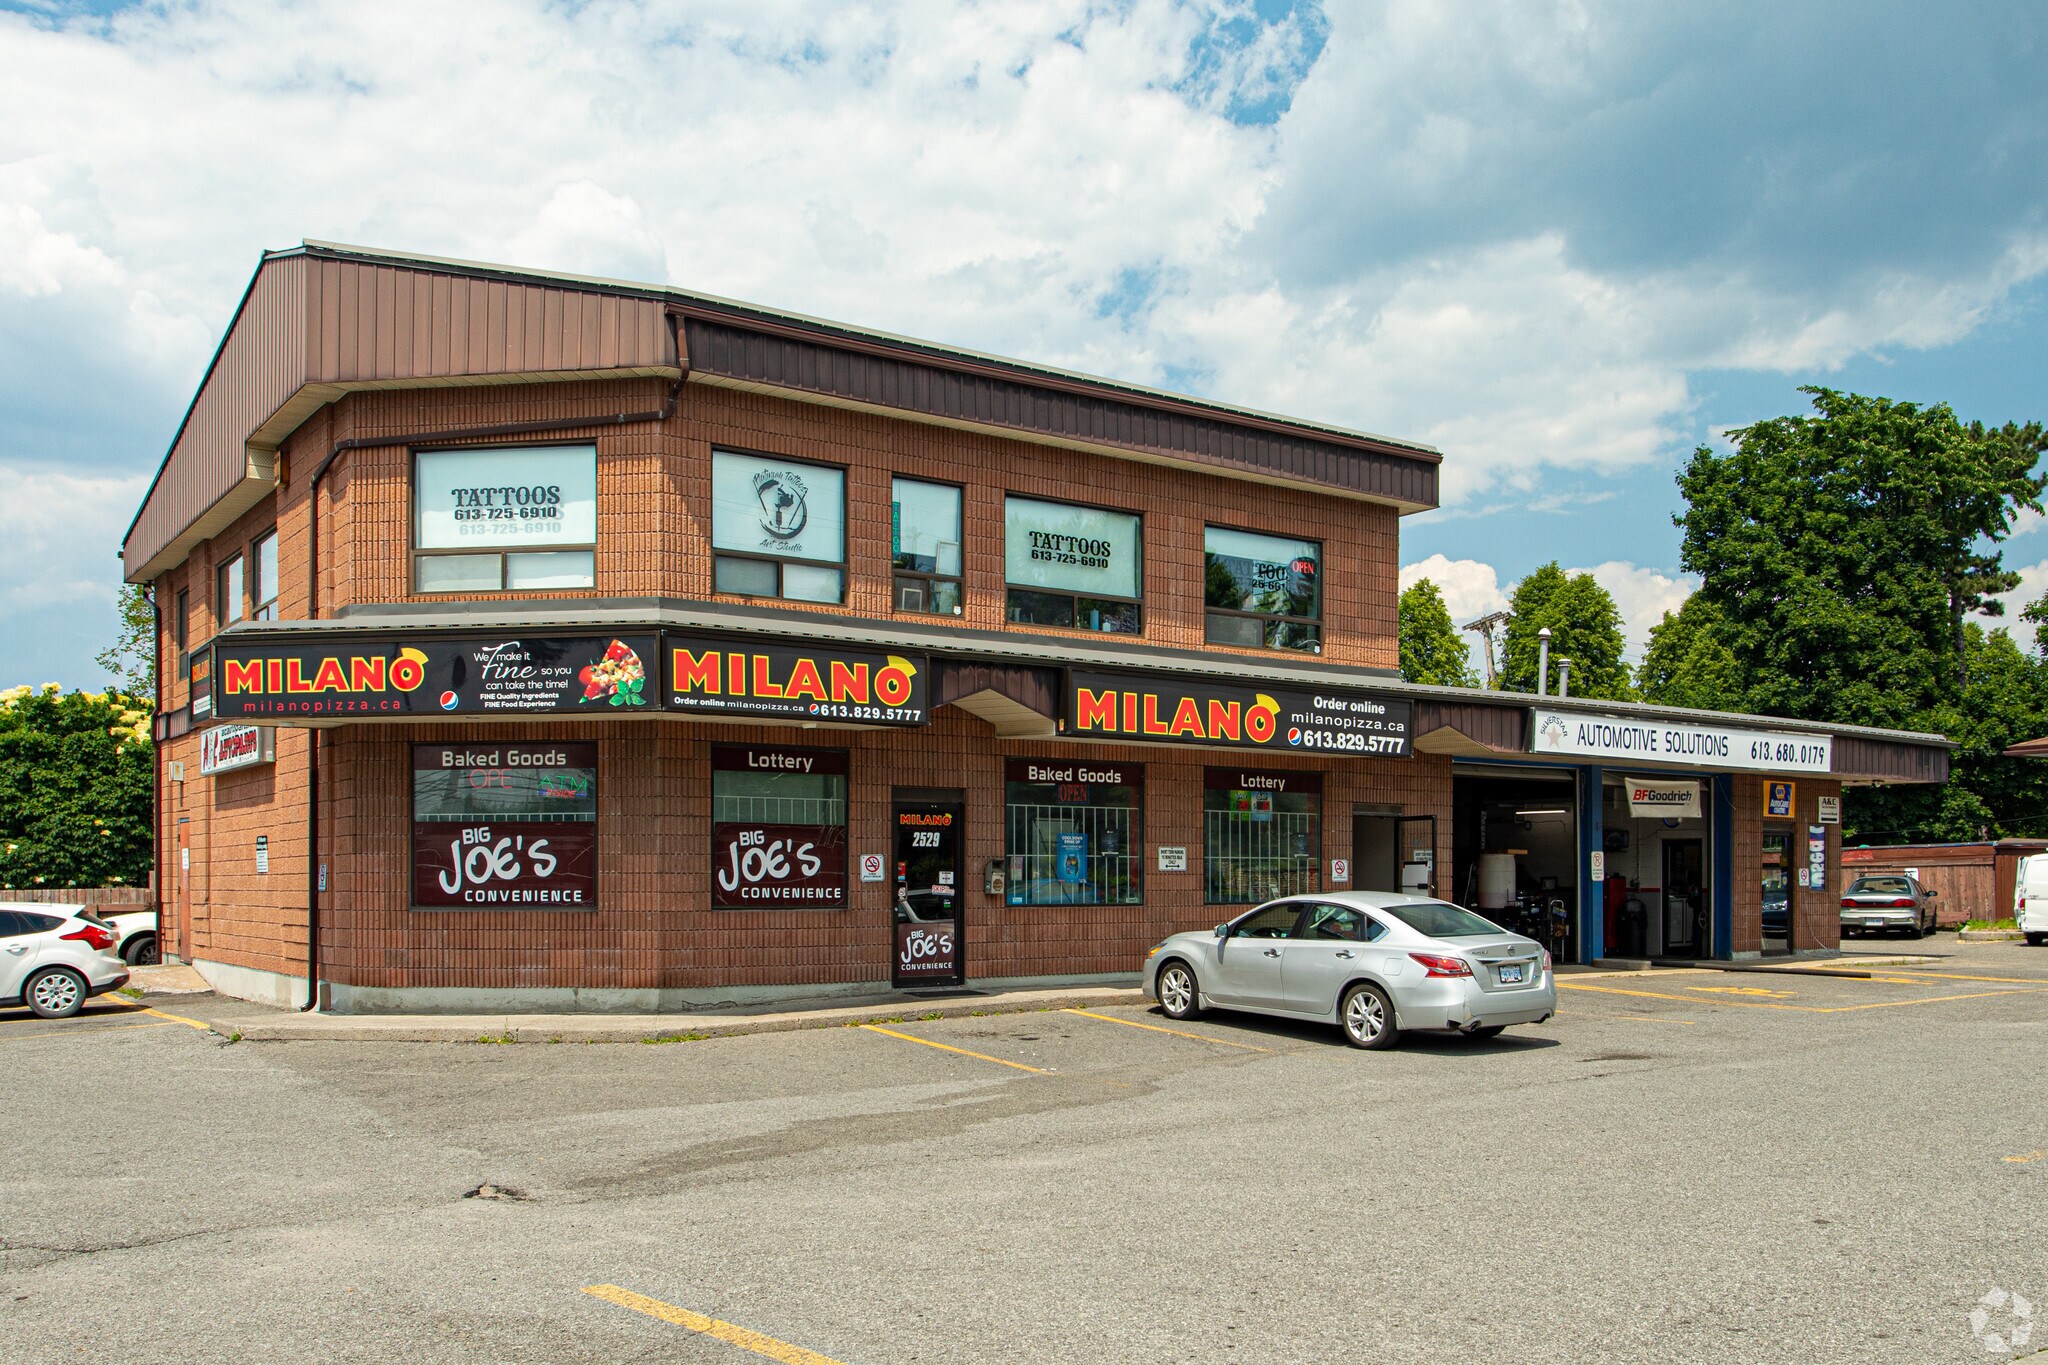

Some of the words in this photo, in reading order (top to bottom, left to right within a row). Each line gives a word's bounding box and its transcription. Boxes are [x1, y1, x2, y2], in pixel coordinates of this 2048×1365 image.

[451, 485, 561, 507] TATTOOS
[454, 506, 557, 520] 613-725-6910
[1028, 530, 1111, 558] TATTOOS
[1031, 549, 1109, 569] 613-725-6910
[1291, 560, 1315, 575] OPEN
[473, 652, 489, 662] We
[496, 651, 522, 661] make
[524, 651, 531, 661] it
[481, 640, 537, 680] Fine
[541, 667, 552, 675] so
[553, 666, 572, 678] you
[224, 648, 429, 695] MILANO
[673, 648, 918, 706] MILANO
[485, 681, 503, 690] can
[505, 680, 525, 690] take
[527, 680, 543, 689] the
[545, 679, 569, 689] time!
[496, 692, 520, 701] Quality
[521, 692, 560, 701] Ingredients
[519, 700, 556, 708] Experience
[1313, 696, 1348, 711] Order
[1350, 701, 1386, 714] online
[243, 699, 401, 713] milanopizza.ca
[674, 696, 698, 706] Order
[699, 698, 726, 707] online
[727, 701, 805, 712] milanopizza.ca
[820, 704, 922, 721] 613.829.5777
[1077, 688, 1281, 743] MILANO
[1291, 712, 1405, 732] milanopizza.ca
[1540, 715, 1568, 738] SILVERSTAR
[1303, 729, 1405, 754] 613.829.5777
[1577, 723, 1658, 752] AUTOMOTIVE
[1665, 731, 1729, 757] SOLUTIONS
[441, 751, 500, 767] Baked
[507, 750, 567, 766] Goods
[748, 751, 814, 773] Lottery
[537, 775, 588, 790] ATM
[1028, 765, 1073, 782] Baked
[1078, 768, 1122, 783] Goods
[1241, 773, 1286, 792] Lottery
[1058, 784, 1087, 801] OPEN
[1632, 789, 1692, 802] BFGoodrich
[900, 813, 952, 826] MILANO
[462, 826, 491, 845] BIG
[739, 830, 765, 846] BIG
[912, 831, 940, 847] 2529
[438, 835, 558, 895] JOE'S
[718, 838, 822, 892] JOE'S
[464, 890, 583, 903] CONVENIENCE
[741, 887, 842, 899] CONVENIENCE
[911, 930, 924, 939] BIG
[900, 933, 953, 964] JOE'S
[901, 961, 953, 971] CONVENIENCE
